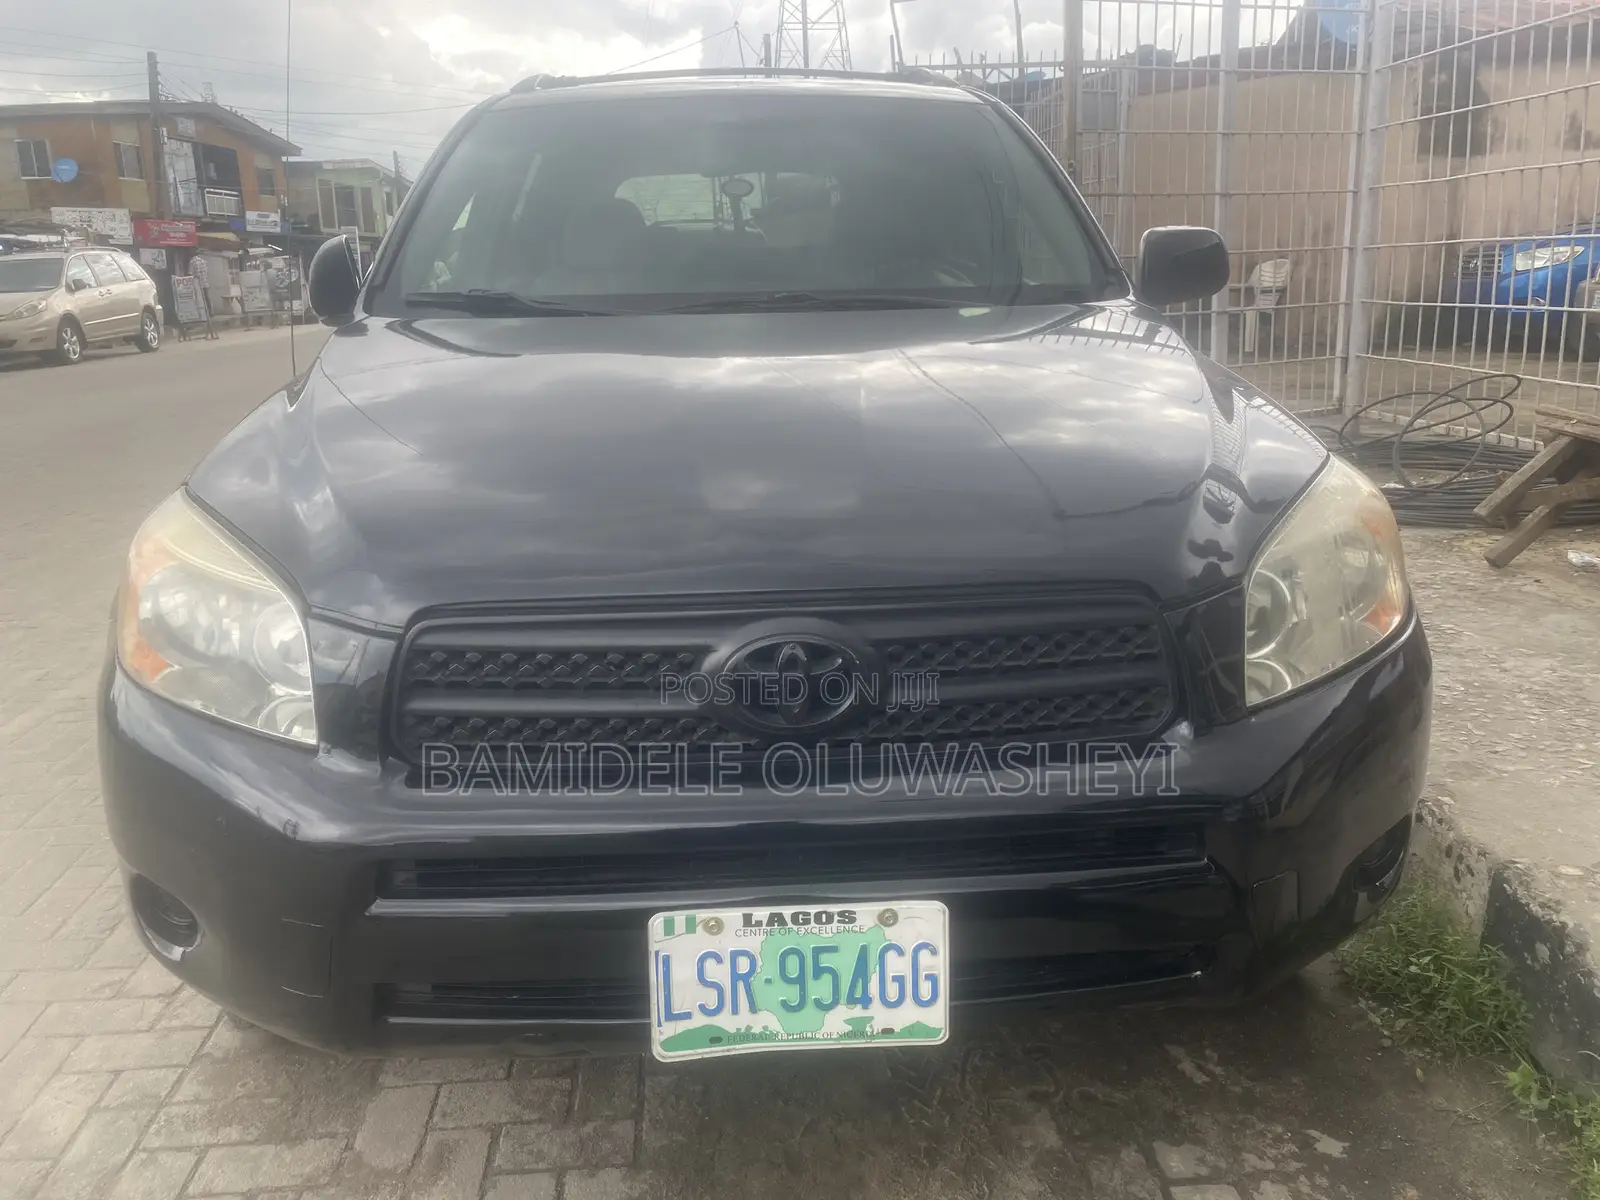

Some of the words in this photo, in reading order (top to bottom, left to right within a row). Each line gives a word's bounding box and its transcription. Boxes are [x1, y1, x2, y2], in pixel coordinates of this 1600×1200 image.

[175, 276, 194, 287] POS
[742, 909, 858, 928] LAGOS
[734, 927, 775, 938] CENTRE
[778, 926, 794, 936] OF
[796, 924, 865, 936] EXCELLENCE
[727, 1033, 770, 1044] FEDERAL
[774, 1030, 820, 1041] REPUBLIC
[821, 1030, 835, 1040] OF
